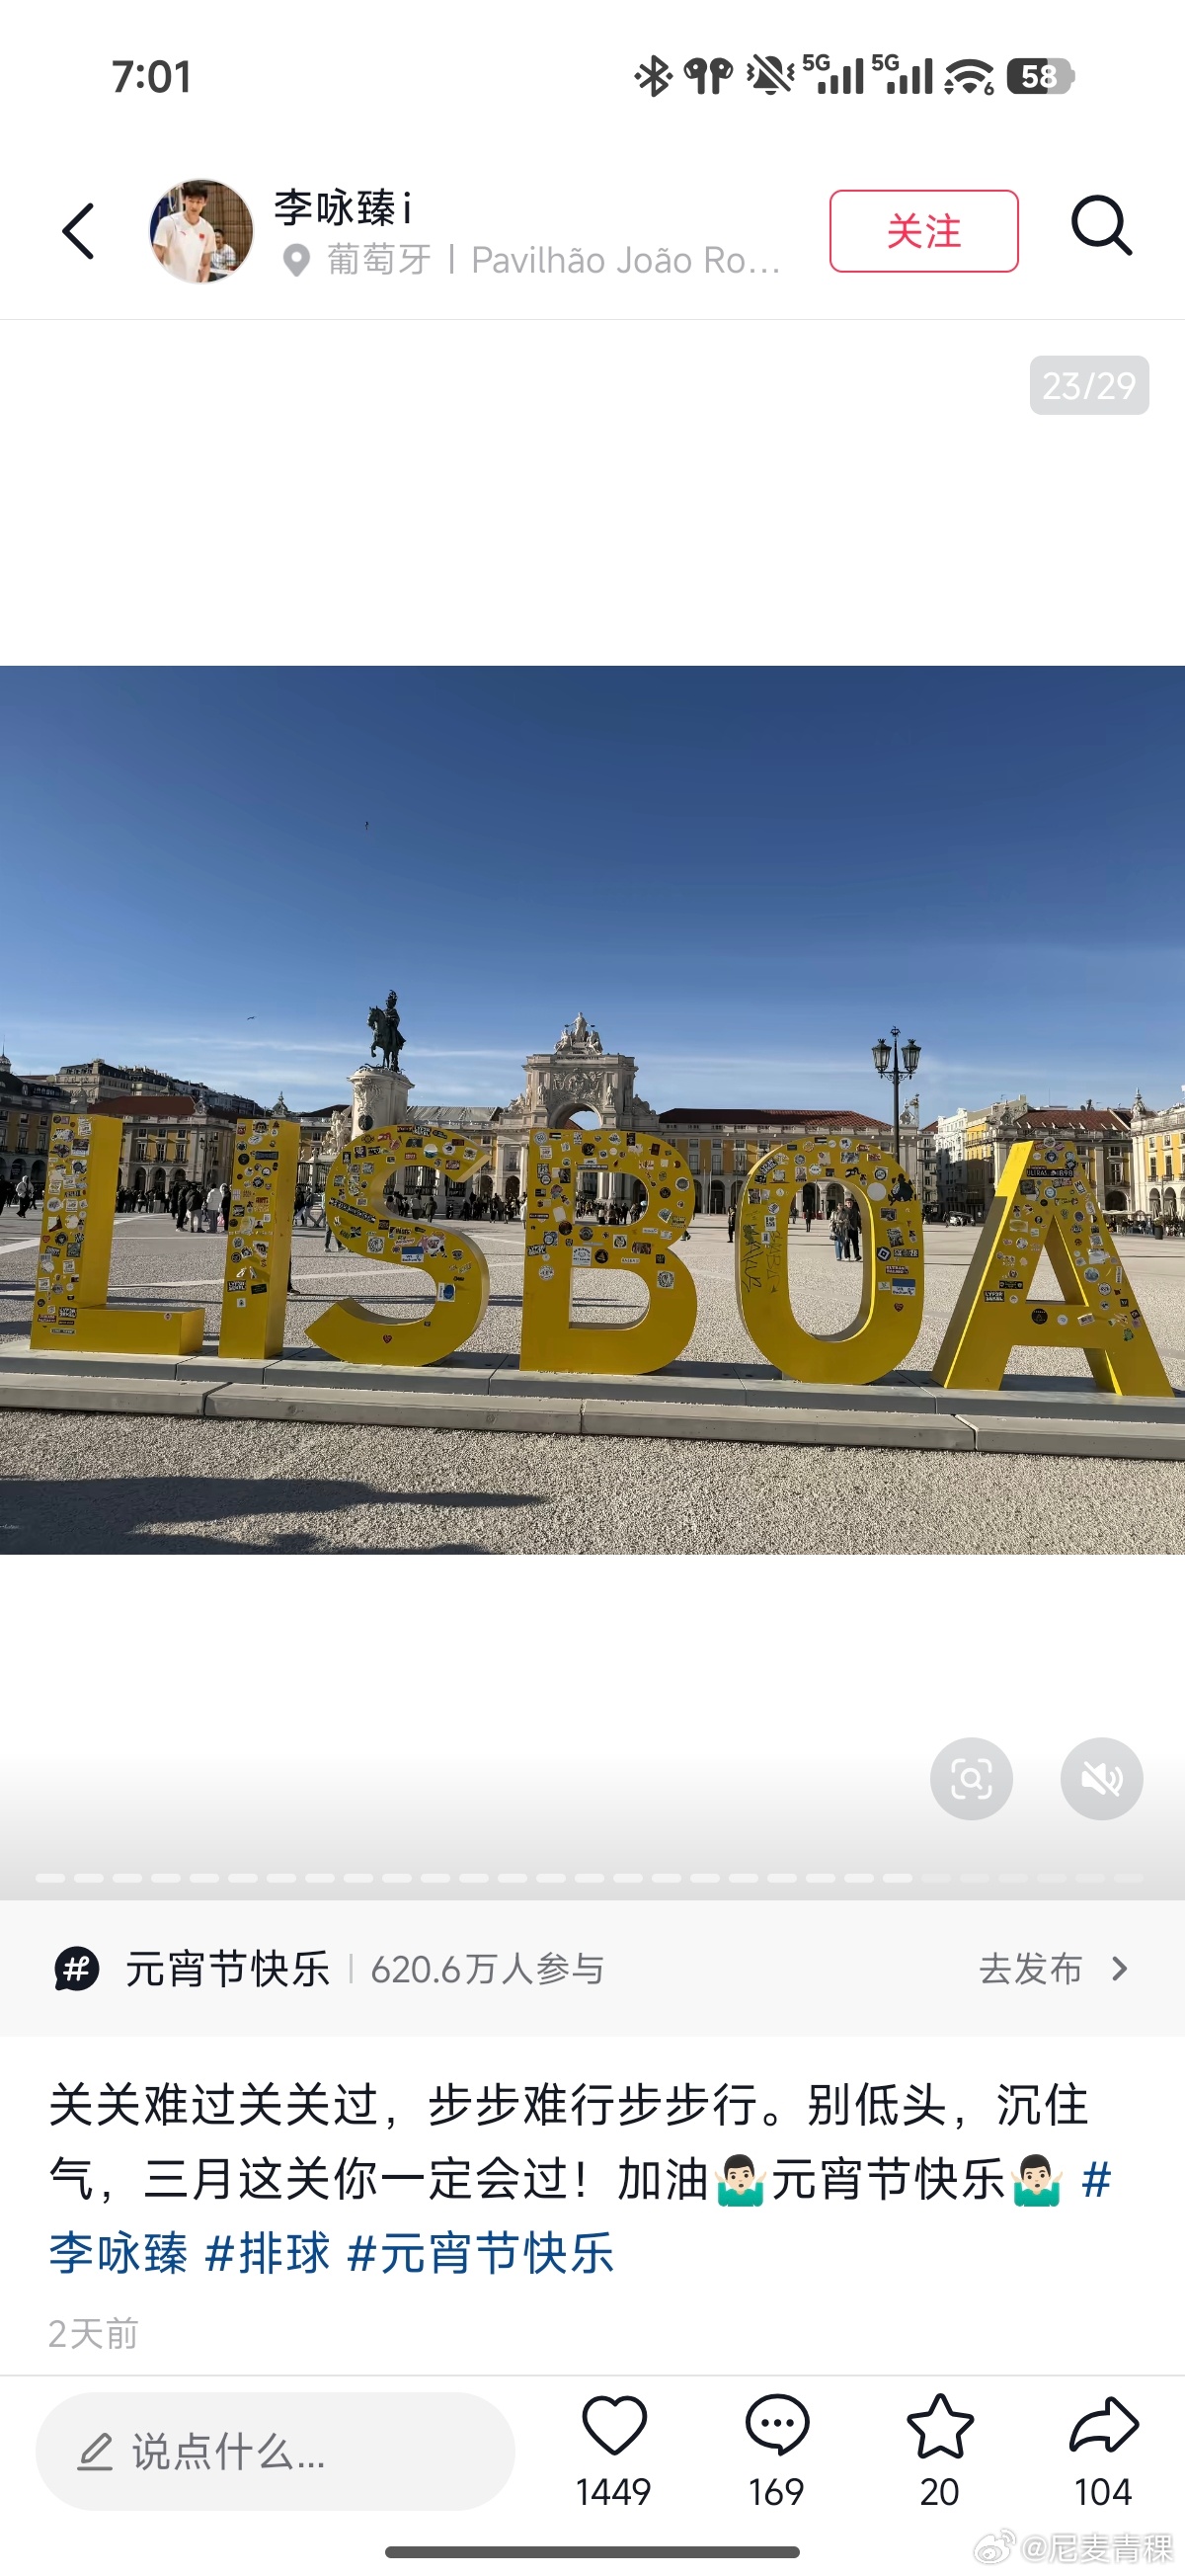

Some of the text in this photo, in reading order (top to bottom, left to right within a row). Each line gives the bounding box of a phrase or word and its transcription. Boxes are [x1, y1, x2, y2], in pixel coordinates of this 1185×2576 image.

[113, 60, 188, 93] 7:01
[802, 53, 830, 72] 5G
[871, 53, 900, 72] 5G
[1021, 64, 1058, 89] 58
[274, 187, 411, 226] 李咏臻i
[889, 211, 961, 249] 关注
[328, 241, 431, 276] 葡萄牙
[473, 245, 605, 274] Pavilhão
[616, 245, 692, 275] João
[1043, 371, 1137, 402] 23/29
[31, 1114, 1175, 1398] LISBOA
[126, 1949, 604, 1987] 元宵节快乐 620.6万人参与
[979, 1952, 1082, 1985] 去发布
[772, 2155, 1005, 2202] 元宵节快乐
[1081, 2160, 1112, 2198] #
[49, 2230, 614, 2276] 李咏臻 #排球 #元宵节快乐
[48, 2316, 139, 2350] 2天前
[577, 2477, 652, 2507] 1449
[750, 2477, 805, 2507] 169
[920, 2477, 960, 2507] 20
[1075, 2477, 1133, 2507] 104
